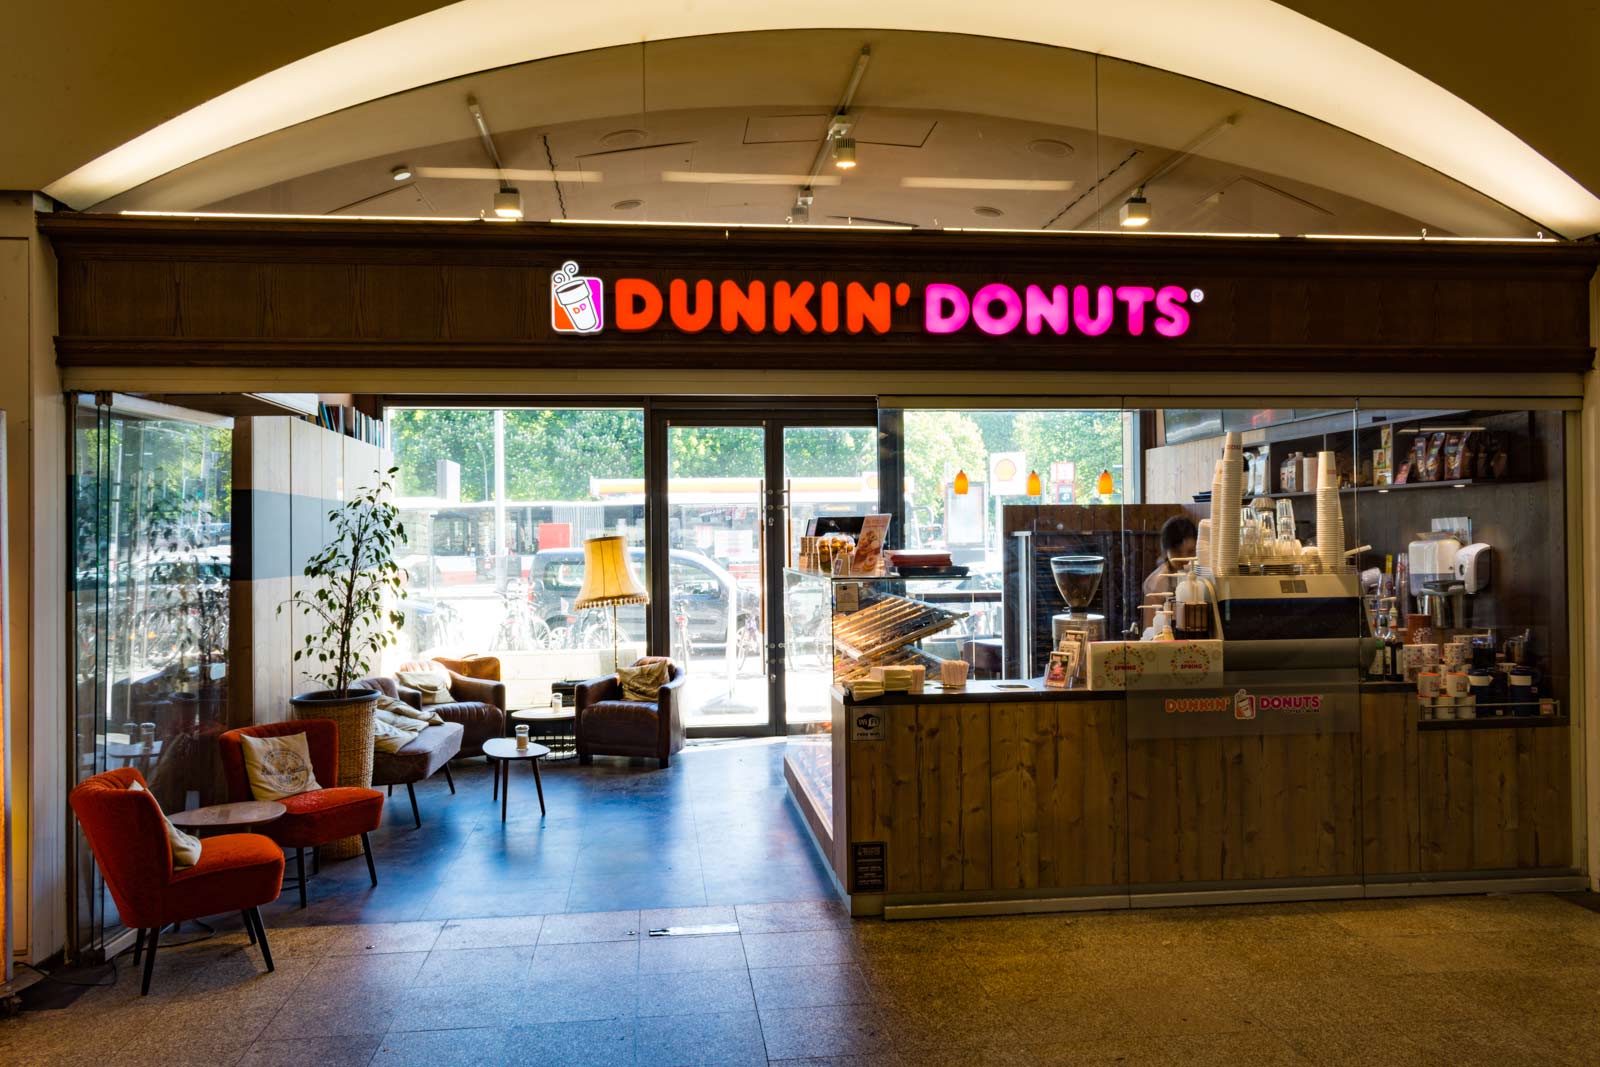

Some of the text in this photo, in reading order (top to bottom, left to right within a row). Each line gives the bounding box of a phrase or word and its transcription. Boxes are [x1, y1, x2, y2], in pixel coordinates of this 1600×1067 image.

[615, 278, 911, 333] DUNKIN'
[925, 283, 1191, 337] DONUTS
[1165, 695, 1321, 713] DUNKIN' DONUTS
